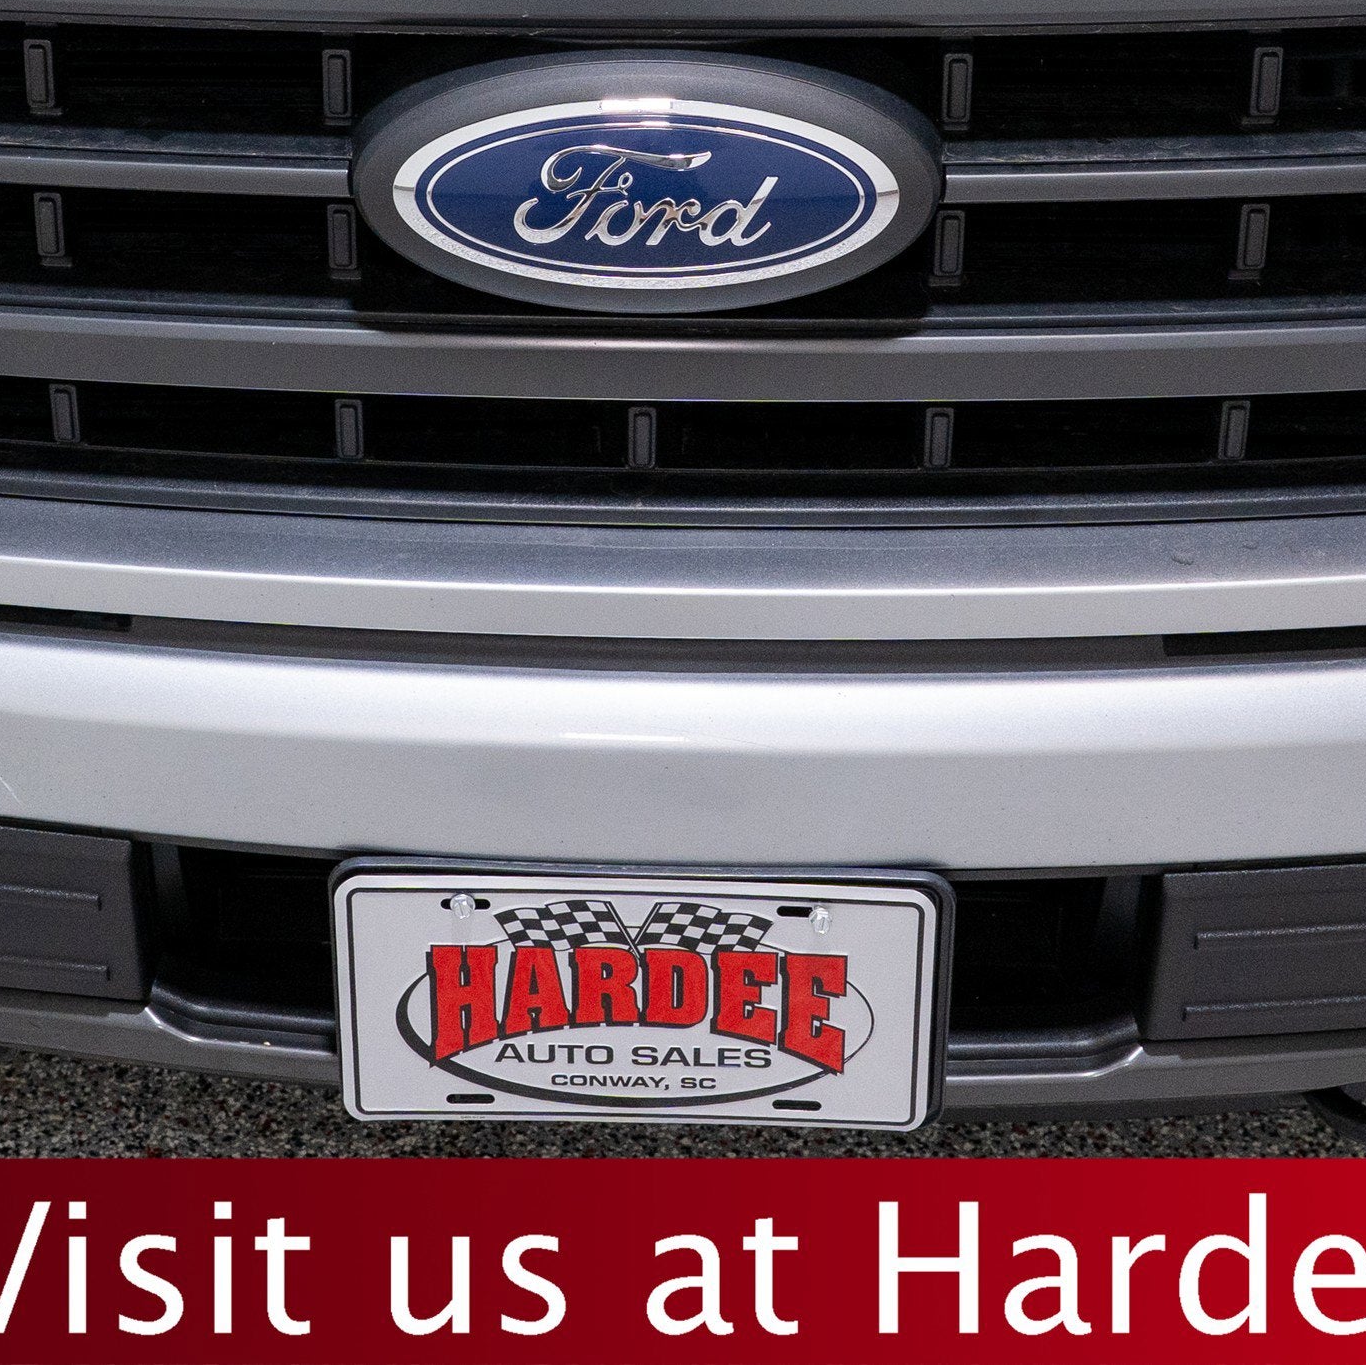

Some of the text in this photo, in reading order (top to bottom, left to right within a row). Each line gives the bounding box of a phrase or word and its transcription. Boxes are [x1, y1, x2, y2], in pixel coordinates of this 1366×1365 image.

[513, 144, 778, 247] Ford
[425, 944, 849, 1075] HARDEE
[494, 1043, 773, 1069] AUTO SALES
[550, 1074, 717, 1091] CONWAY, SC
